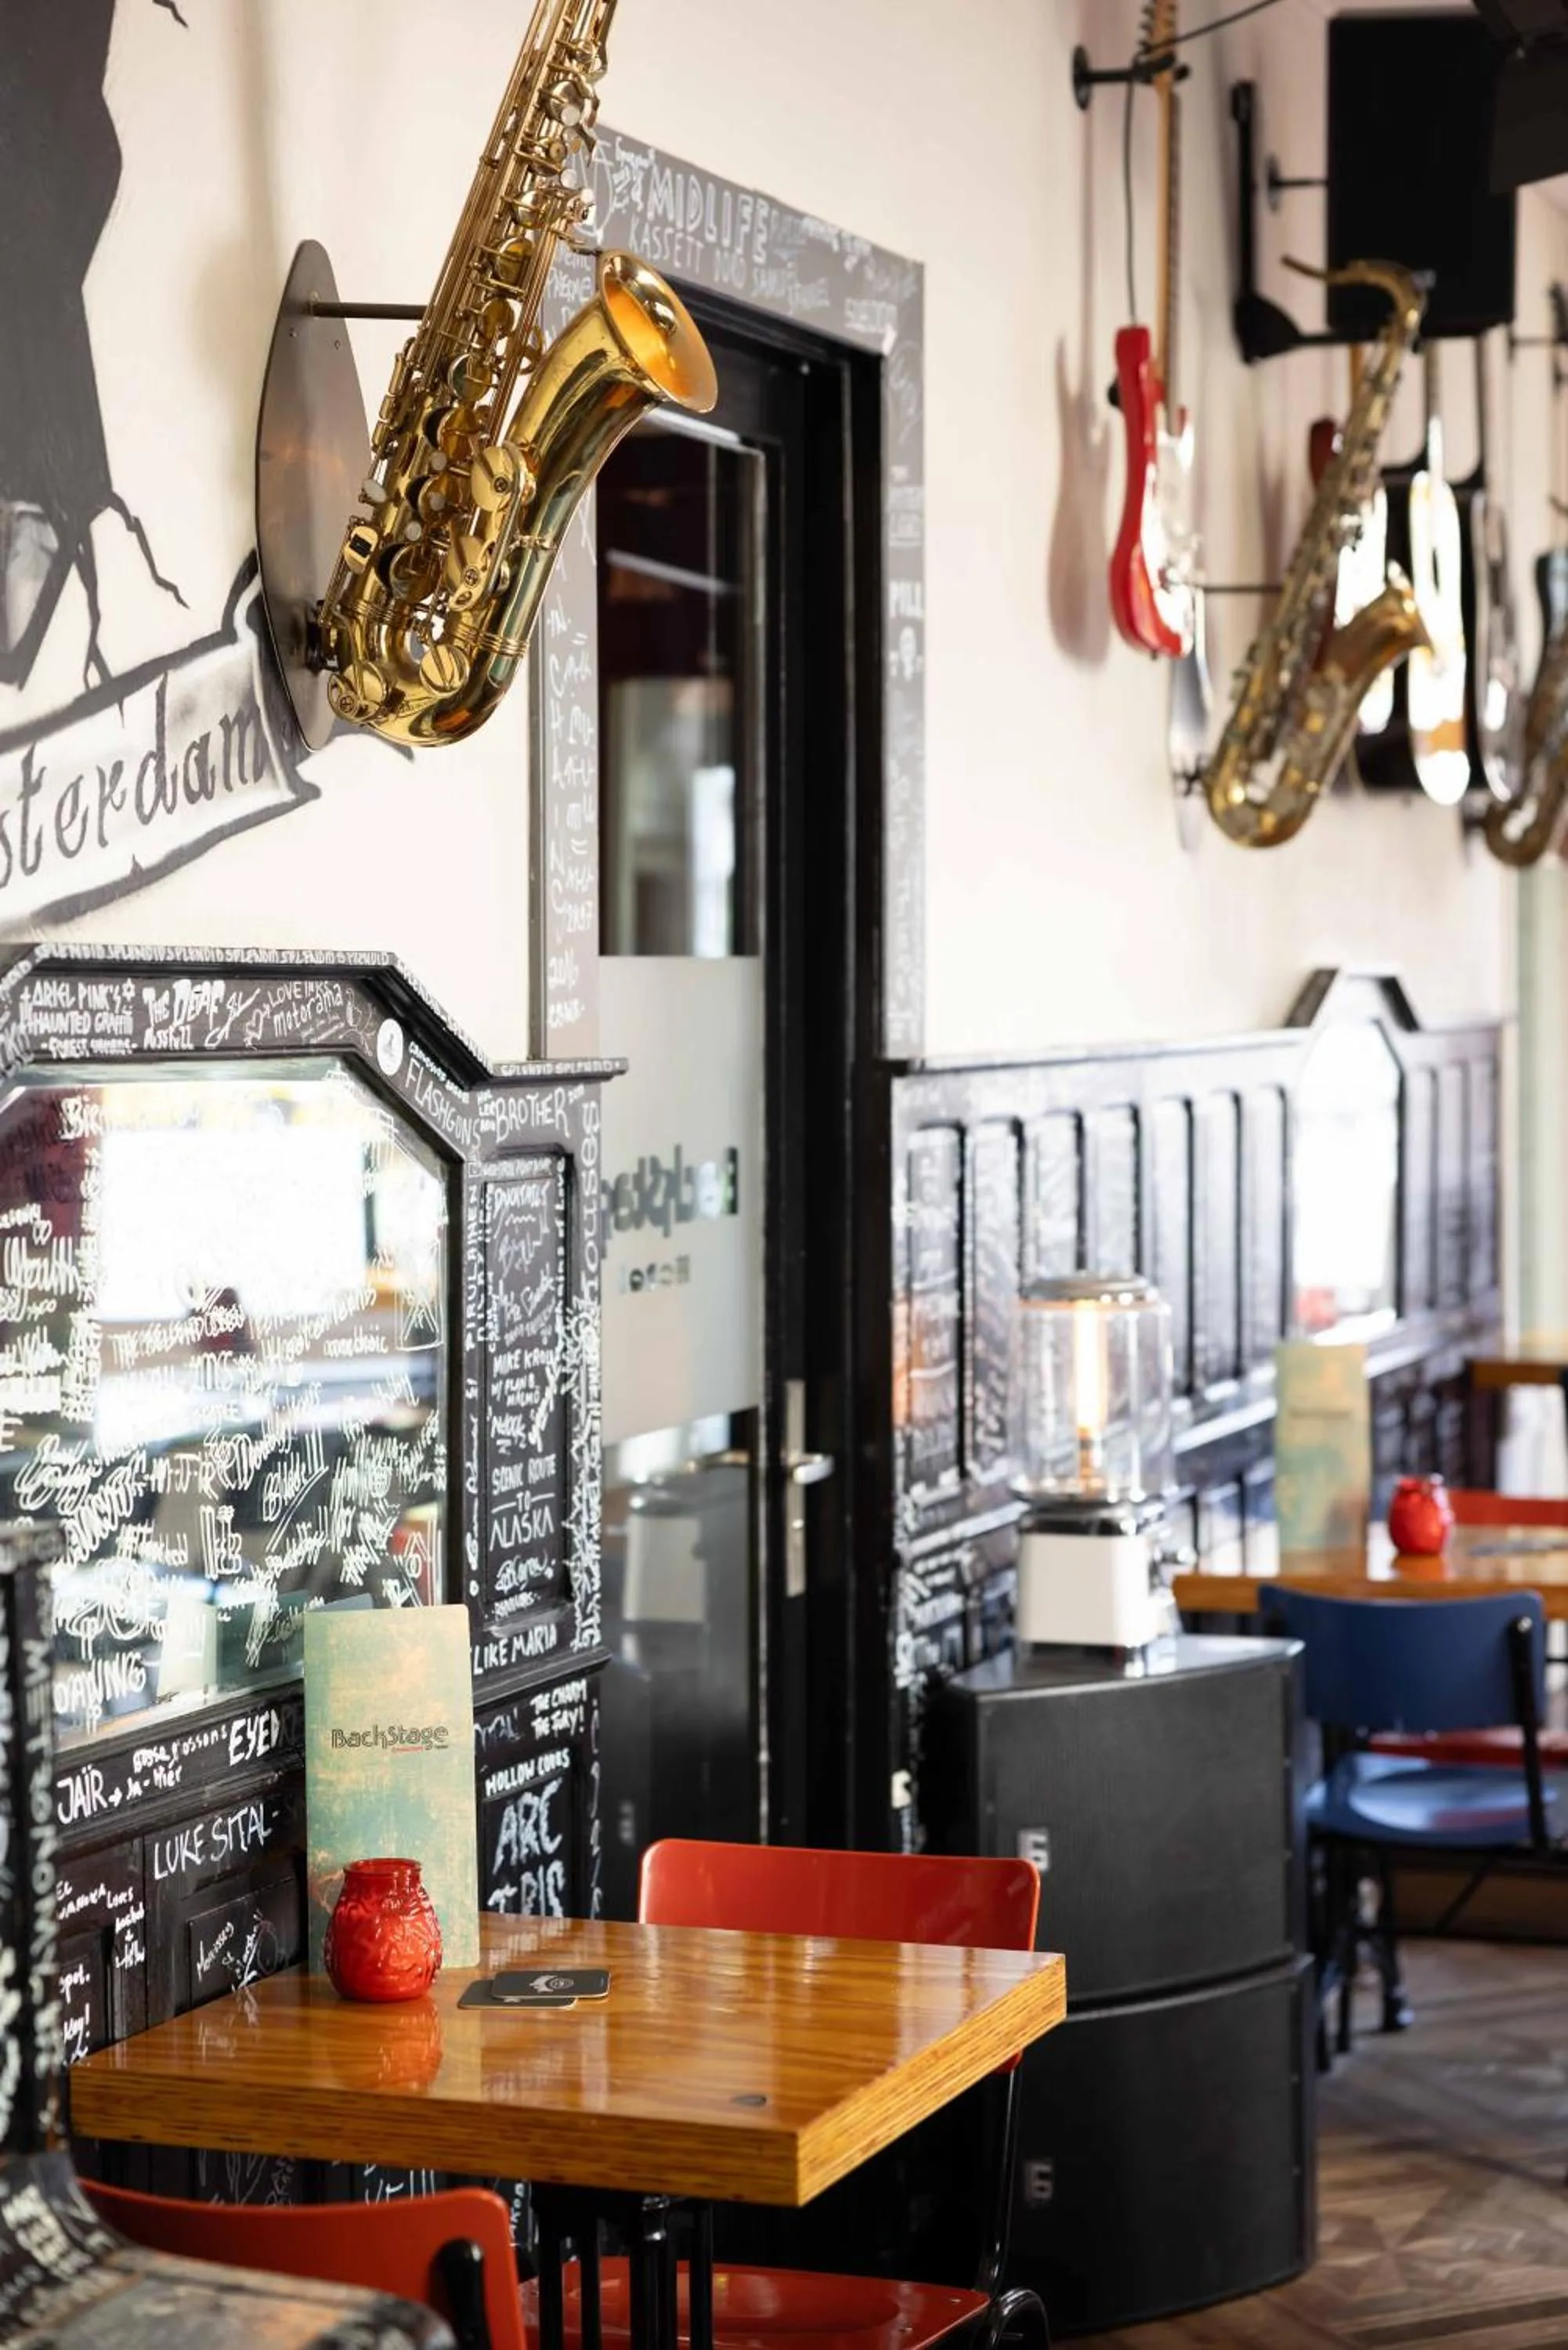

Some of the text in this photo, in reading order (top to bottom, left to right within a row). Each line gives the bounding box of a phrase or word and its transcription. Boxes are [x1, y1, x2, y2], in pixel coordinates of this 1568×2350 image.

[267, 981, 303, 1008] LOVE
[496, 1086, 571, 1144] BROTHER
[515, 1489, 532, 1513] TO
[489, 1505, 555, 1552] ALASKA
[473, 1637, 509, 1676] LIKE
[331, 1723, 450, 1751] BackStage
[484, 1758, 536, 1798] HOLLOW
[154, 1824, 205, 1881] LUKE
